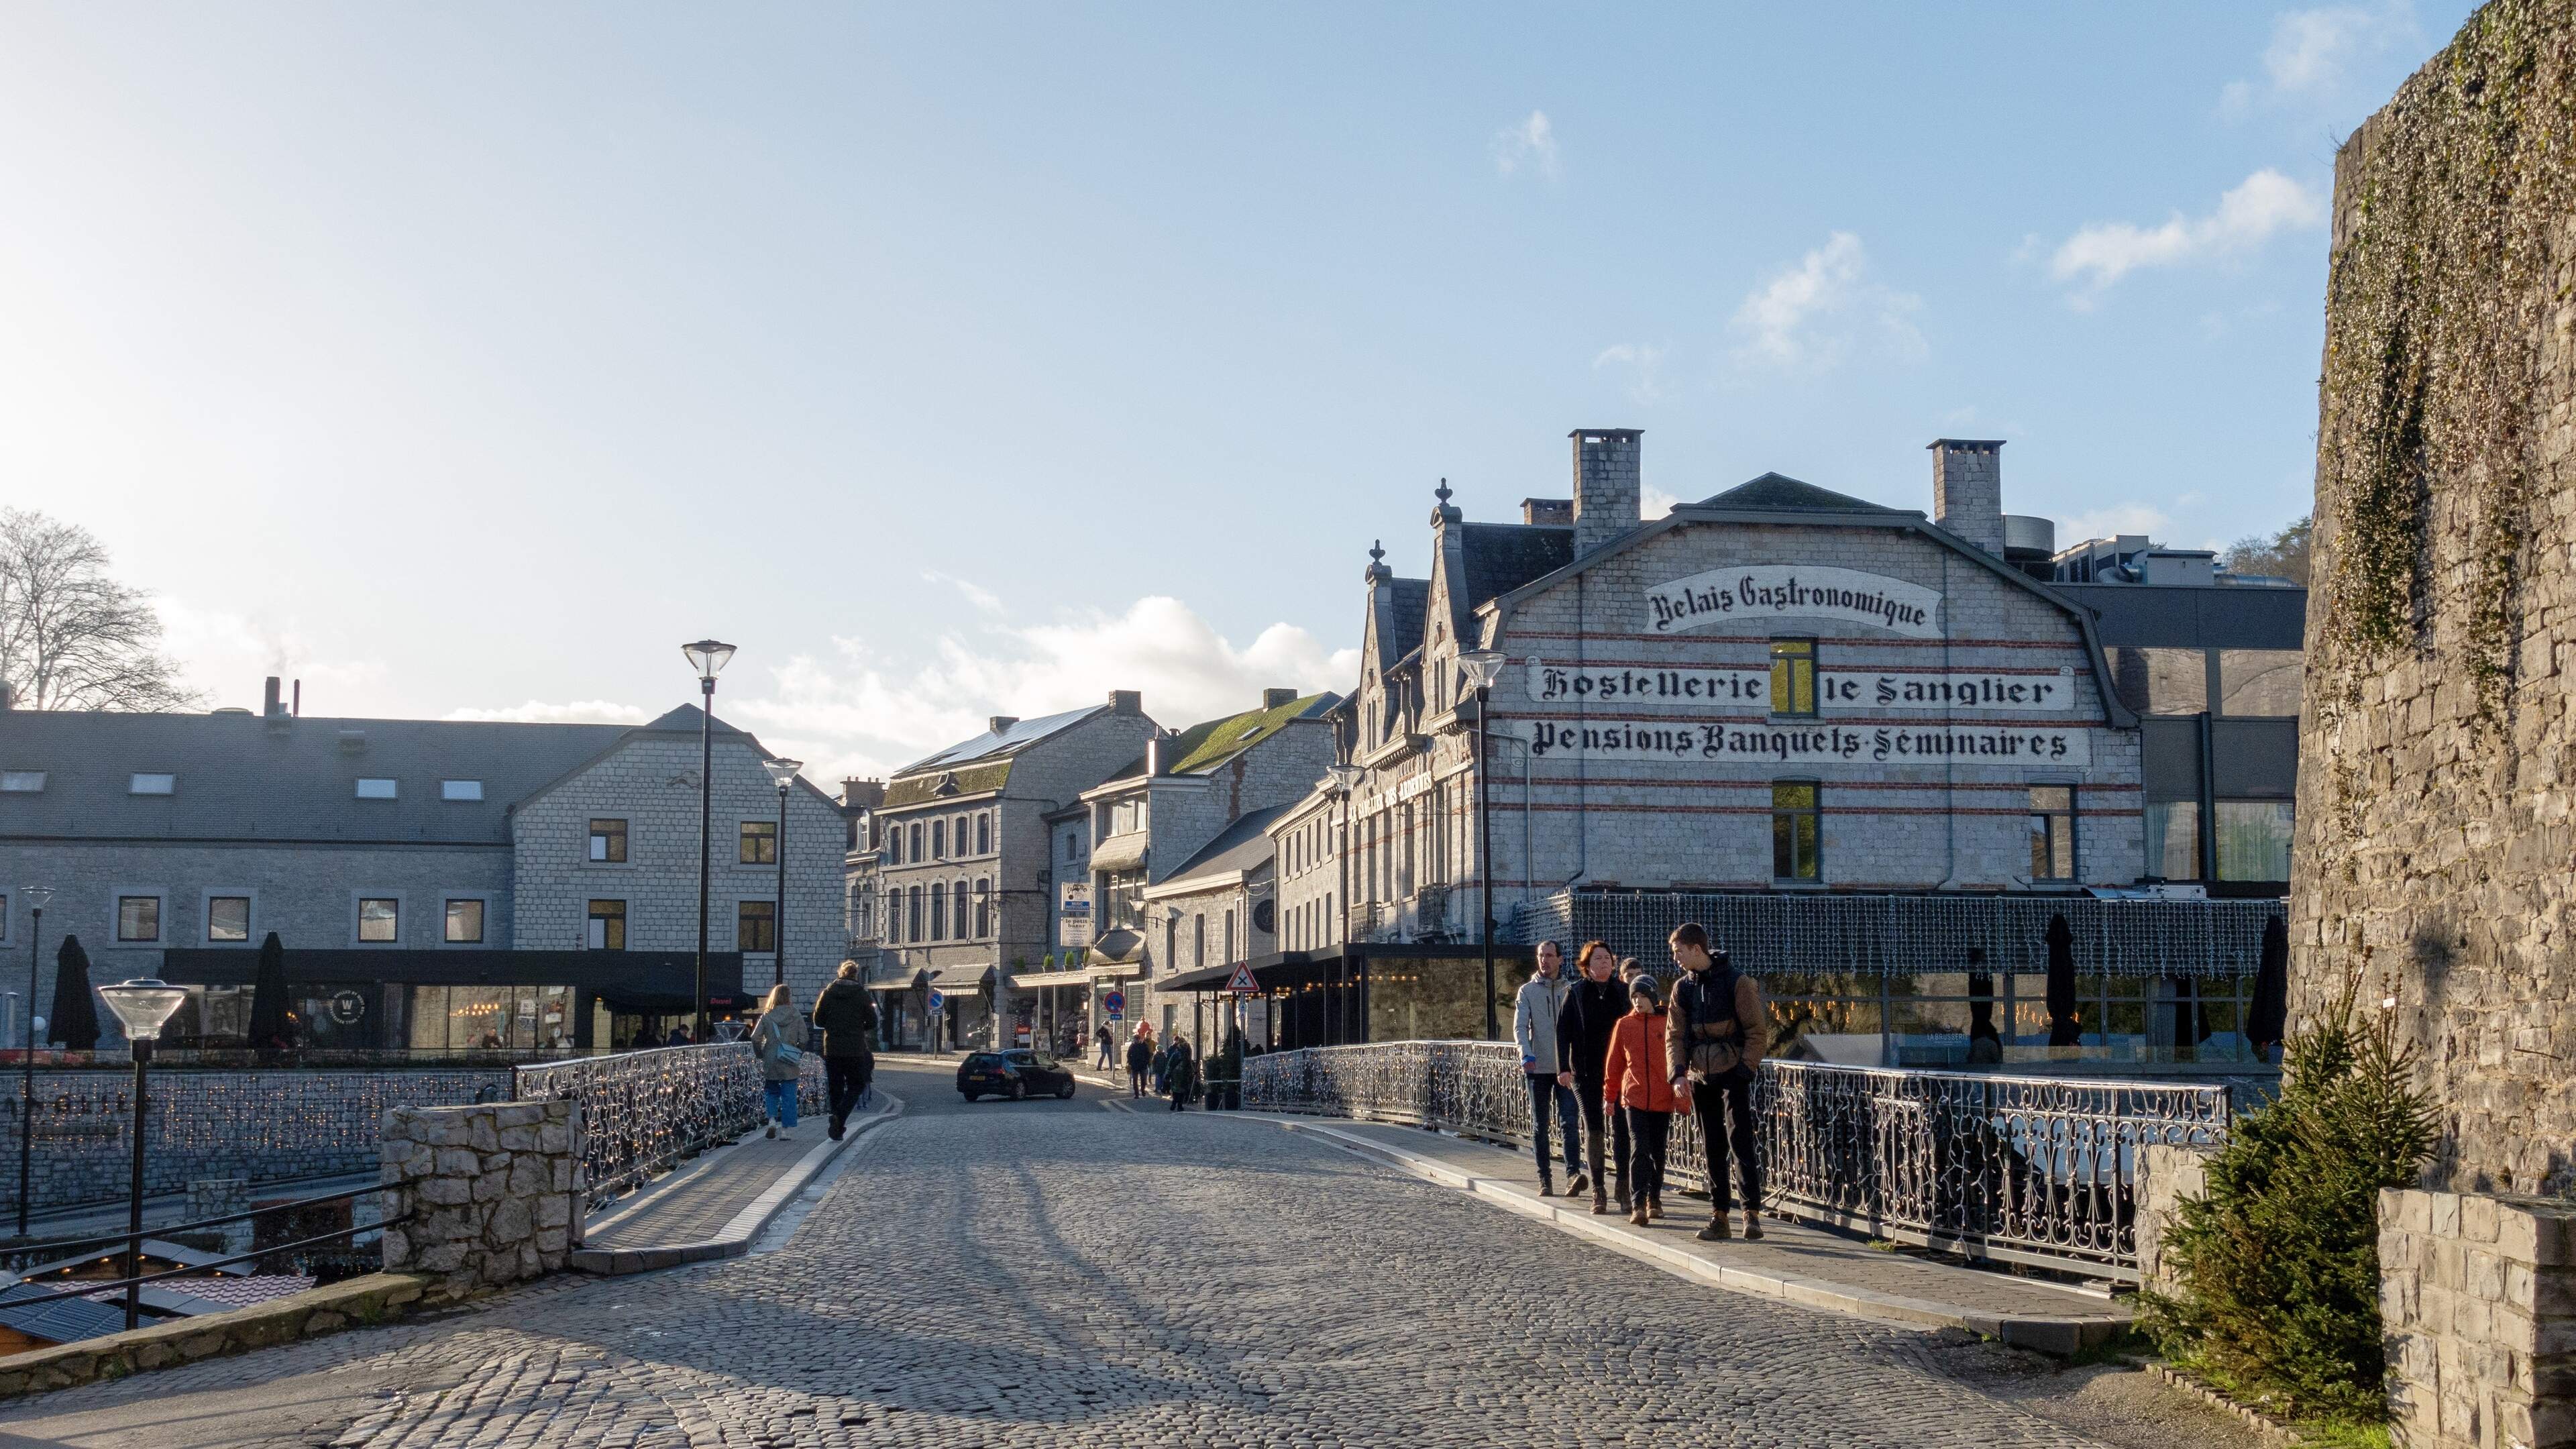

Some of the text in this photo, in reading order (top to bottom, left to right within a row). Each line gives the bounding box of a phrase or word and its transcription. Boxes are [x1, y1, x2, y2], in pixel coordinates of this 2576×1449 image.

[1651, 574, 1926, 631] Relais Gastronomique
[1543, 668, 2053, 706] Hostellerie le Sanglier
[1532, 721, 2068, 761] Pensions Banquets Séminaires
[1358, 793, 1383, 820] SANGLIER
[1385, 786, 1397, 808] DES
[1399, 771, 1432, 802] ARDENNES
[342, 1000, 353, 1010] W
